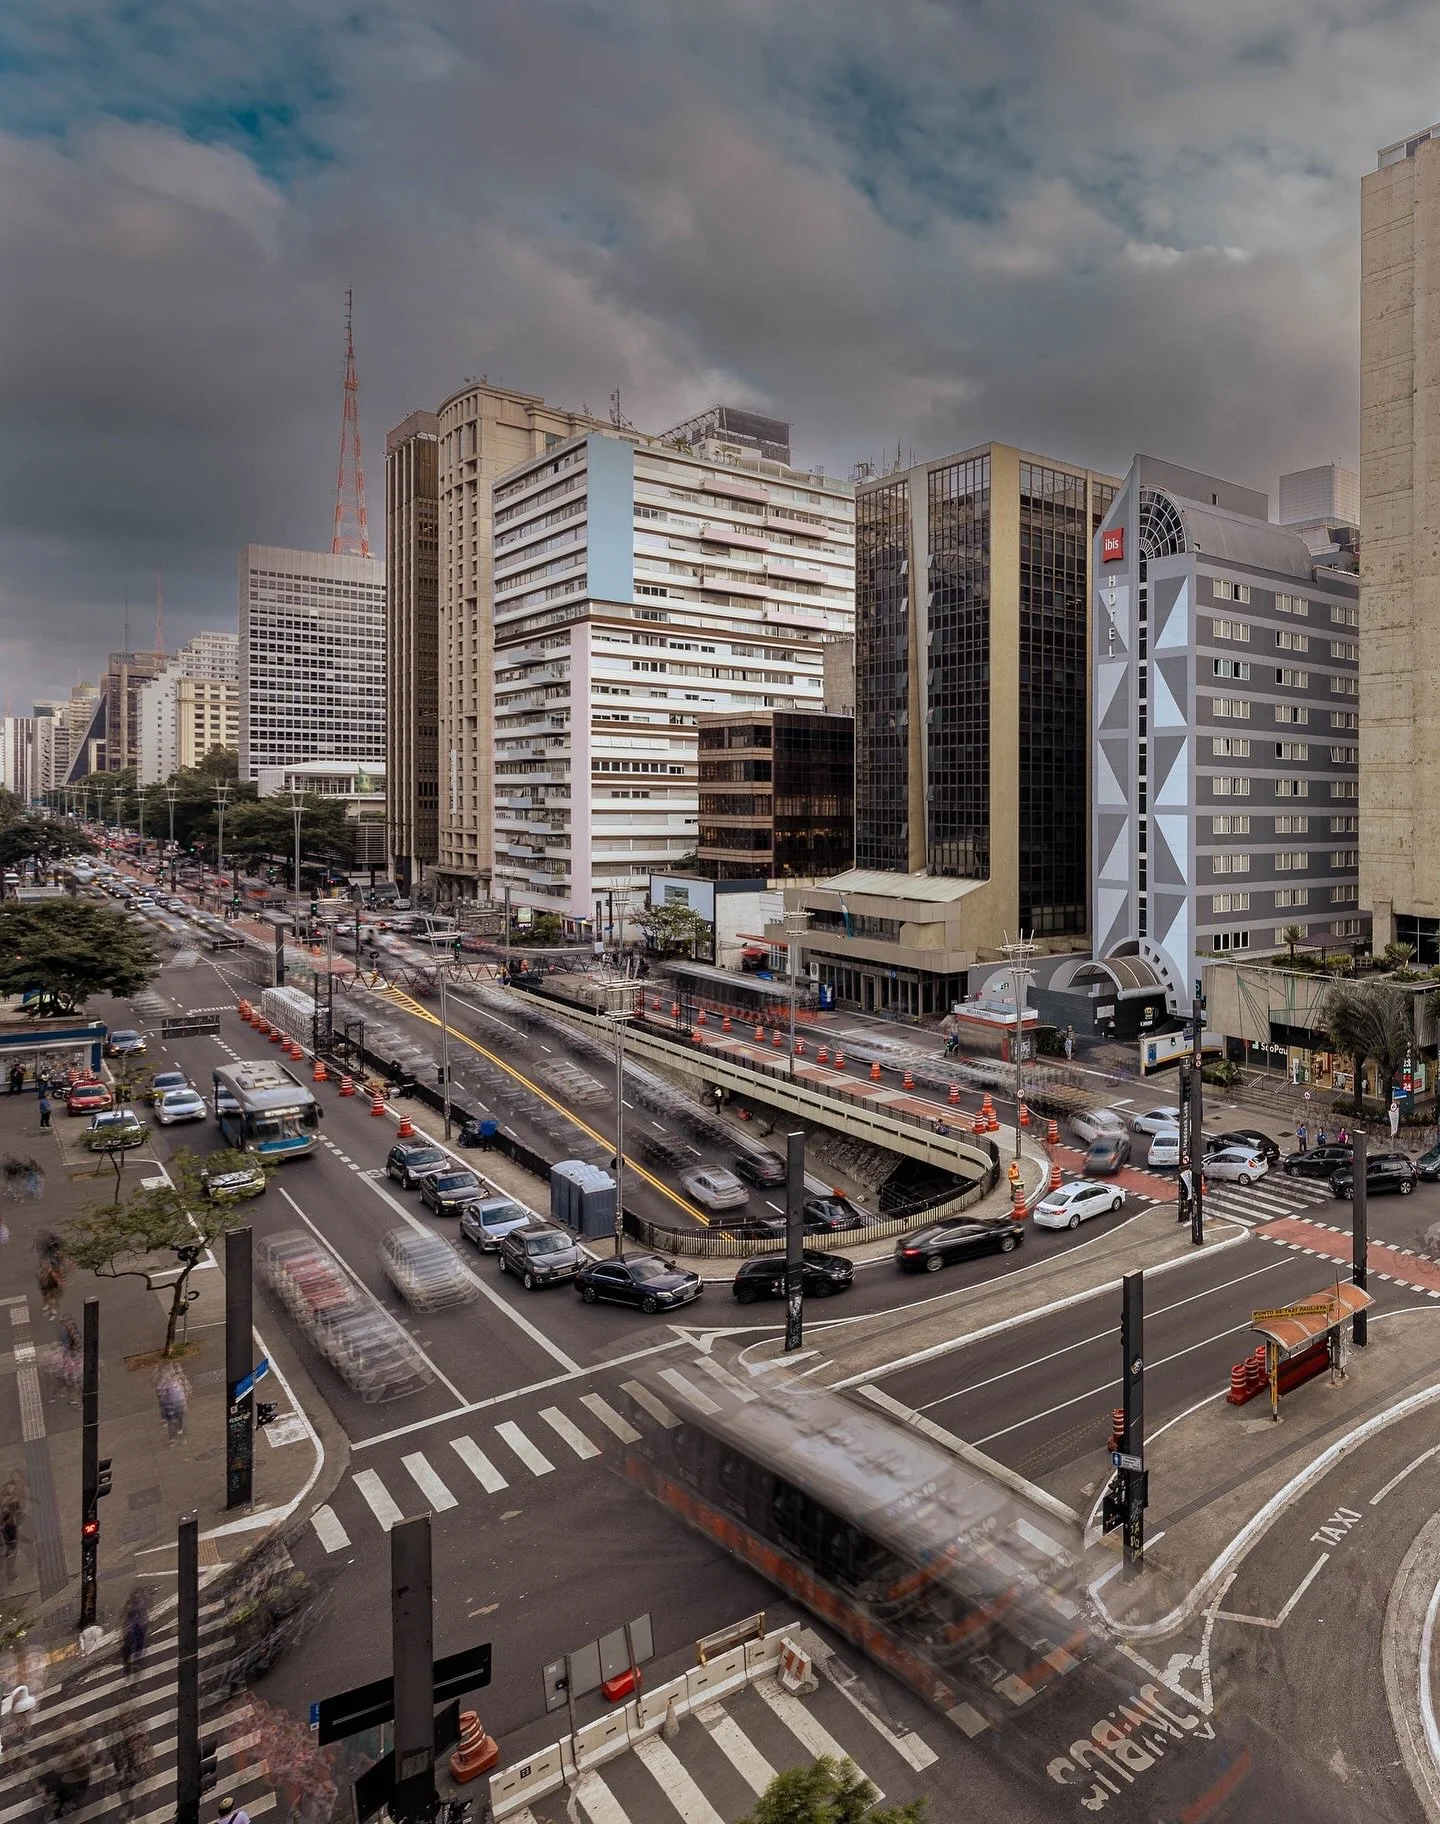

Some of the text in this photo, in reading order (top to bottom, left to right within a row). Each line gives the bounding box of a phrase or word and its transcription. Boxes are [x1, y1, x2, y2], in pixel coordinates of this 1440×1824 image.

[1105, 537, 1119, 551] ibis
[1108, 575, 1116, 658] HOTEL
[1310, 1507, 1363, 1546] TAXI
